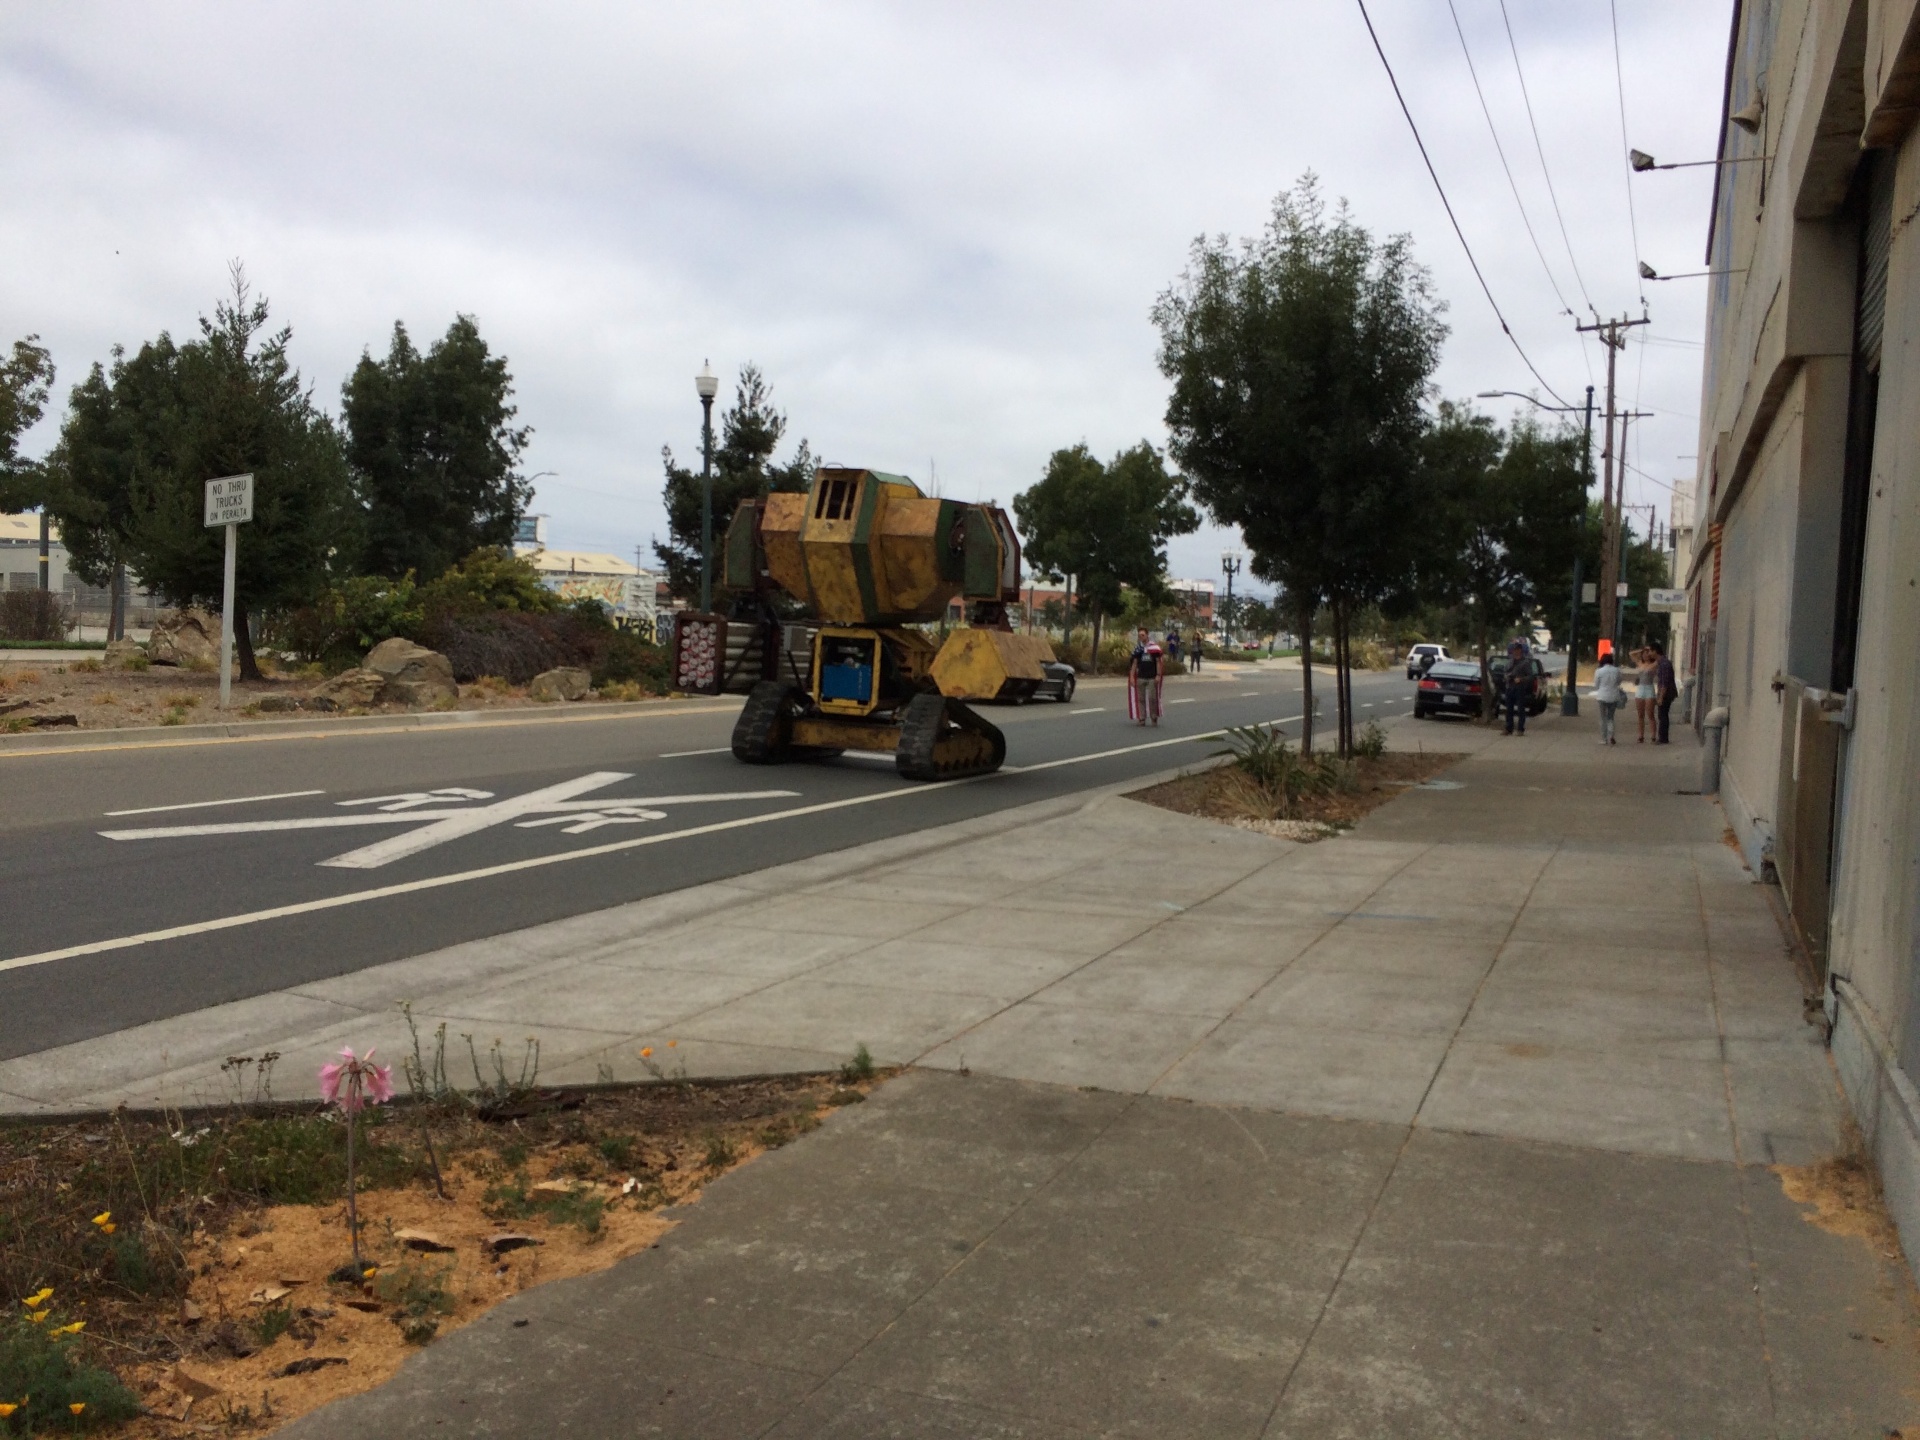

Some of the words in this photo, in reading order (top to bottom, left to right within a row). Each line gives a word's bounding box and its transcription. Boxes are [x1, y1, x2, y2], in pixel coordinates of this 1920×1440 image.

[212, 484, 223, 496] NO
[228, 480, 247, 493] THRU
[215, 494, 243, 509] TRUCKS
[210, 511, 218, 521] ON
[222, 507, 247, 520] PERALTA
